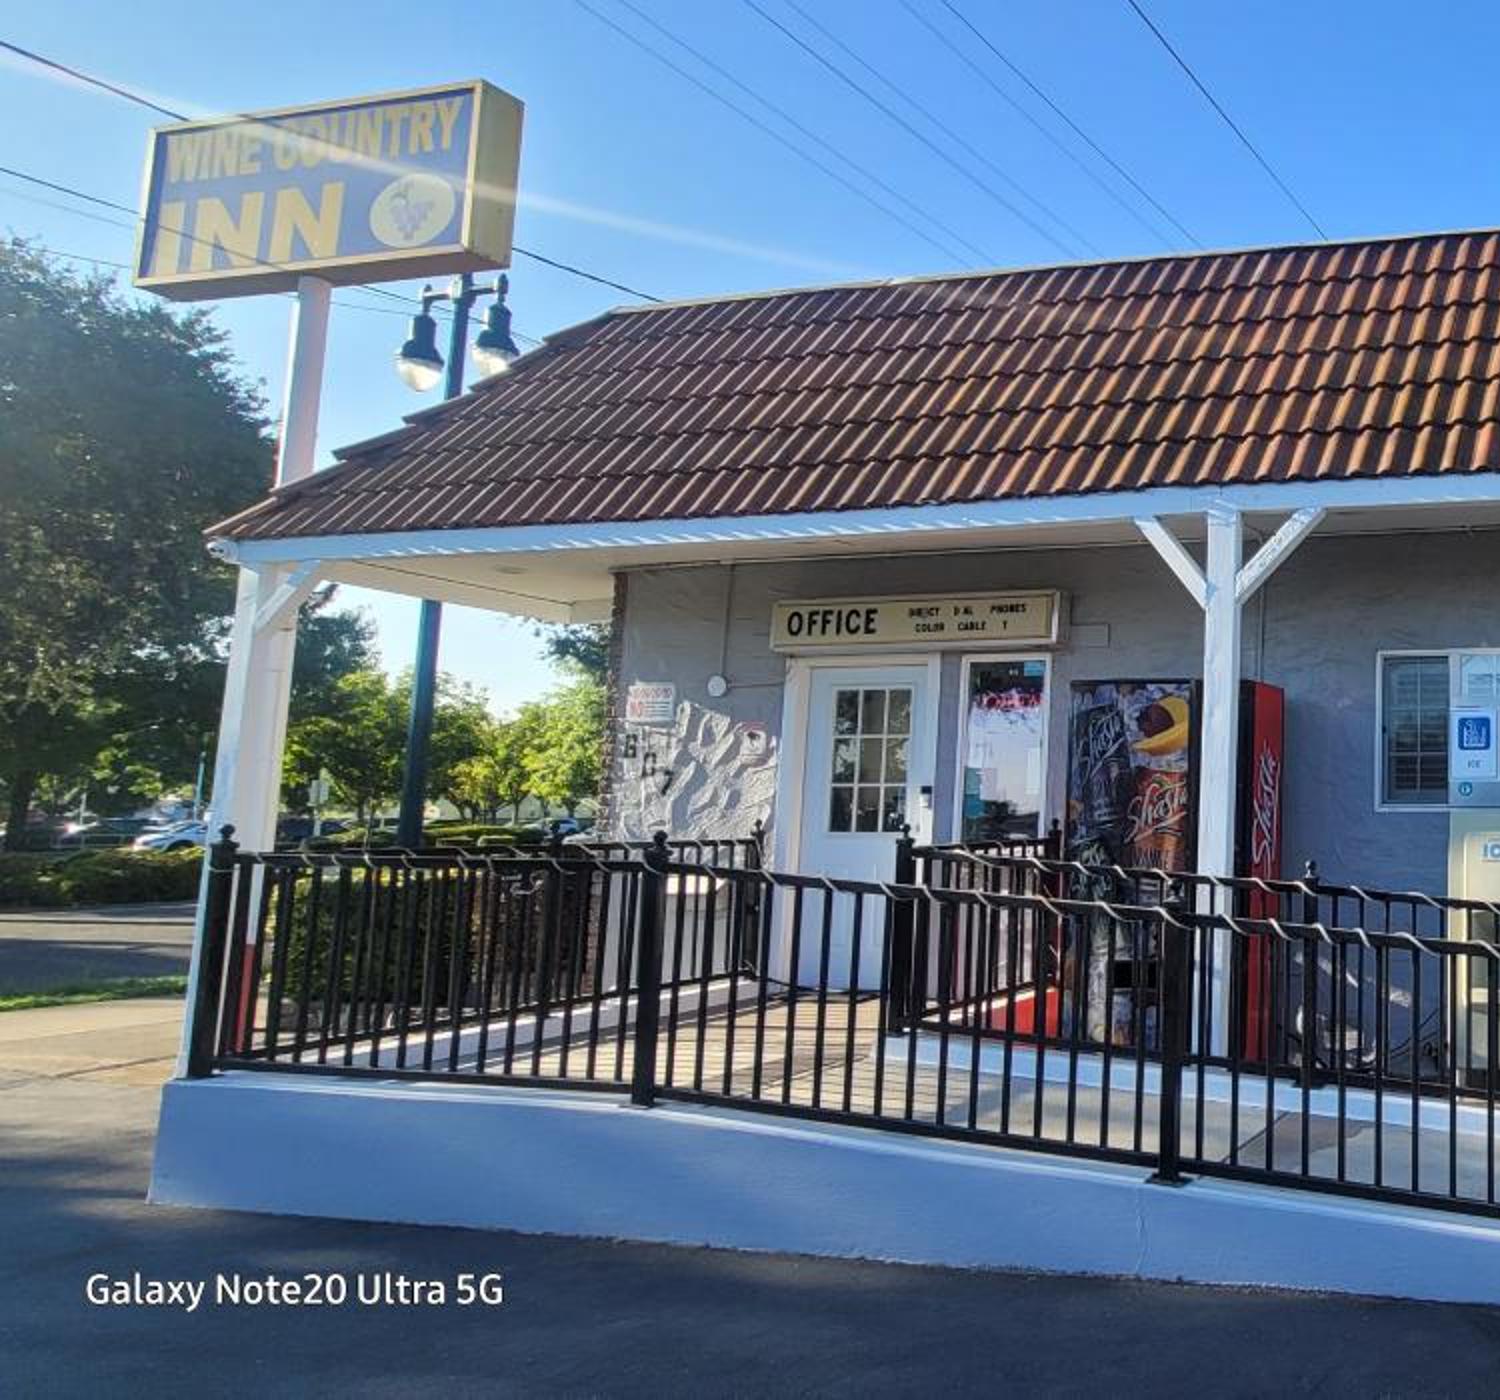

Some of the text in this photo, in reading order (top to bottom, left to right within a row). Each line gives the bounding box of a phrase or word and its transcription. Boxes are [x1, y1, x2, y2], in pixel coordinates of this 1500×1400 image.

[167, 97, 464, 183] WINE COUNTRY
[153, 181, 345, 277] INN
[787, 607, 878, 637] OFFICE
[915, 622, 945, 633] COLOR
